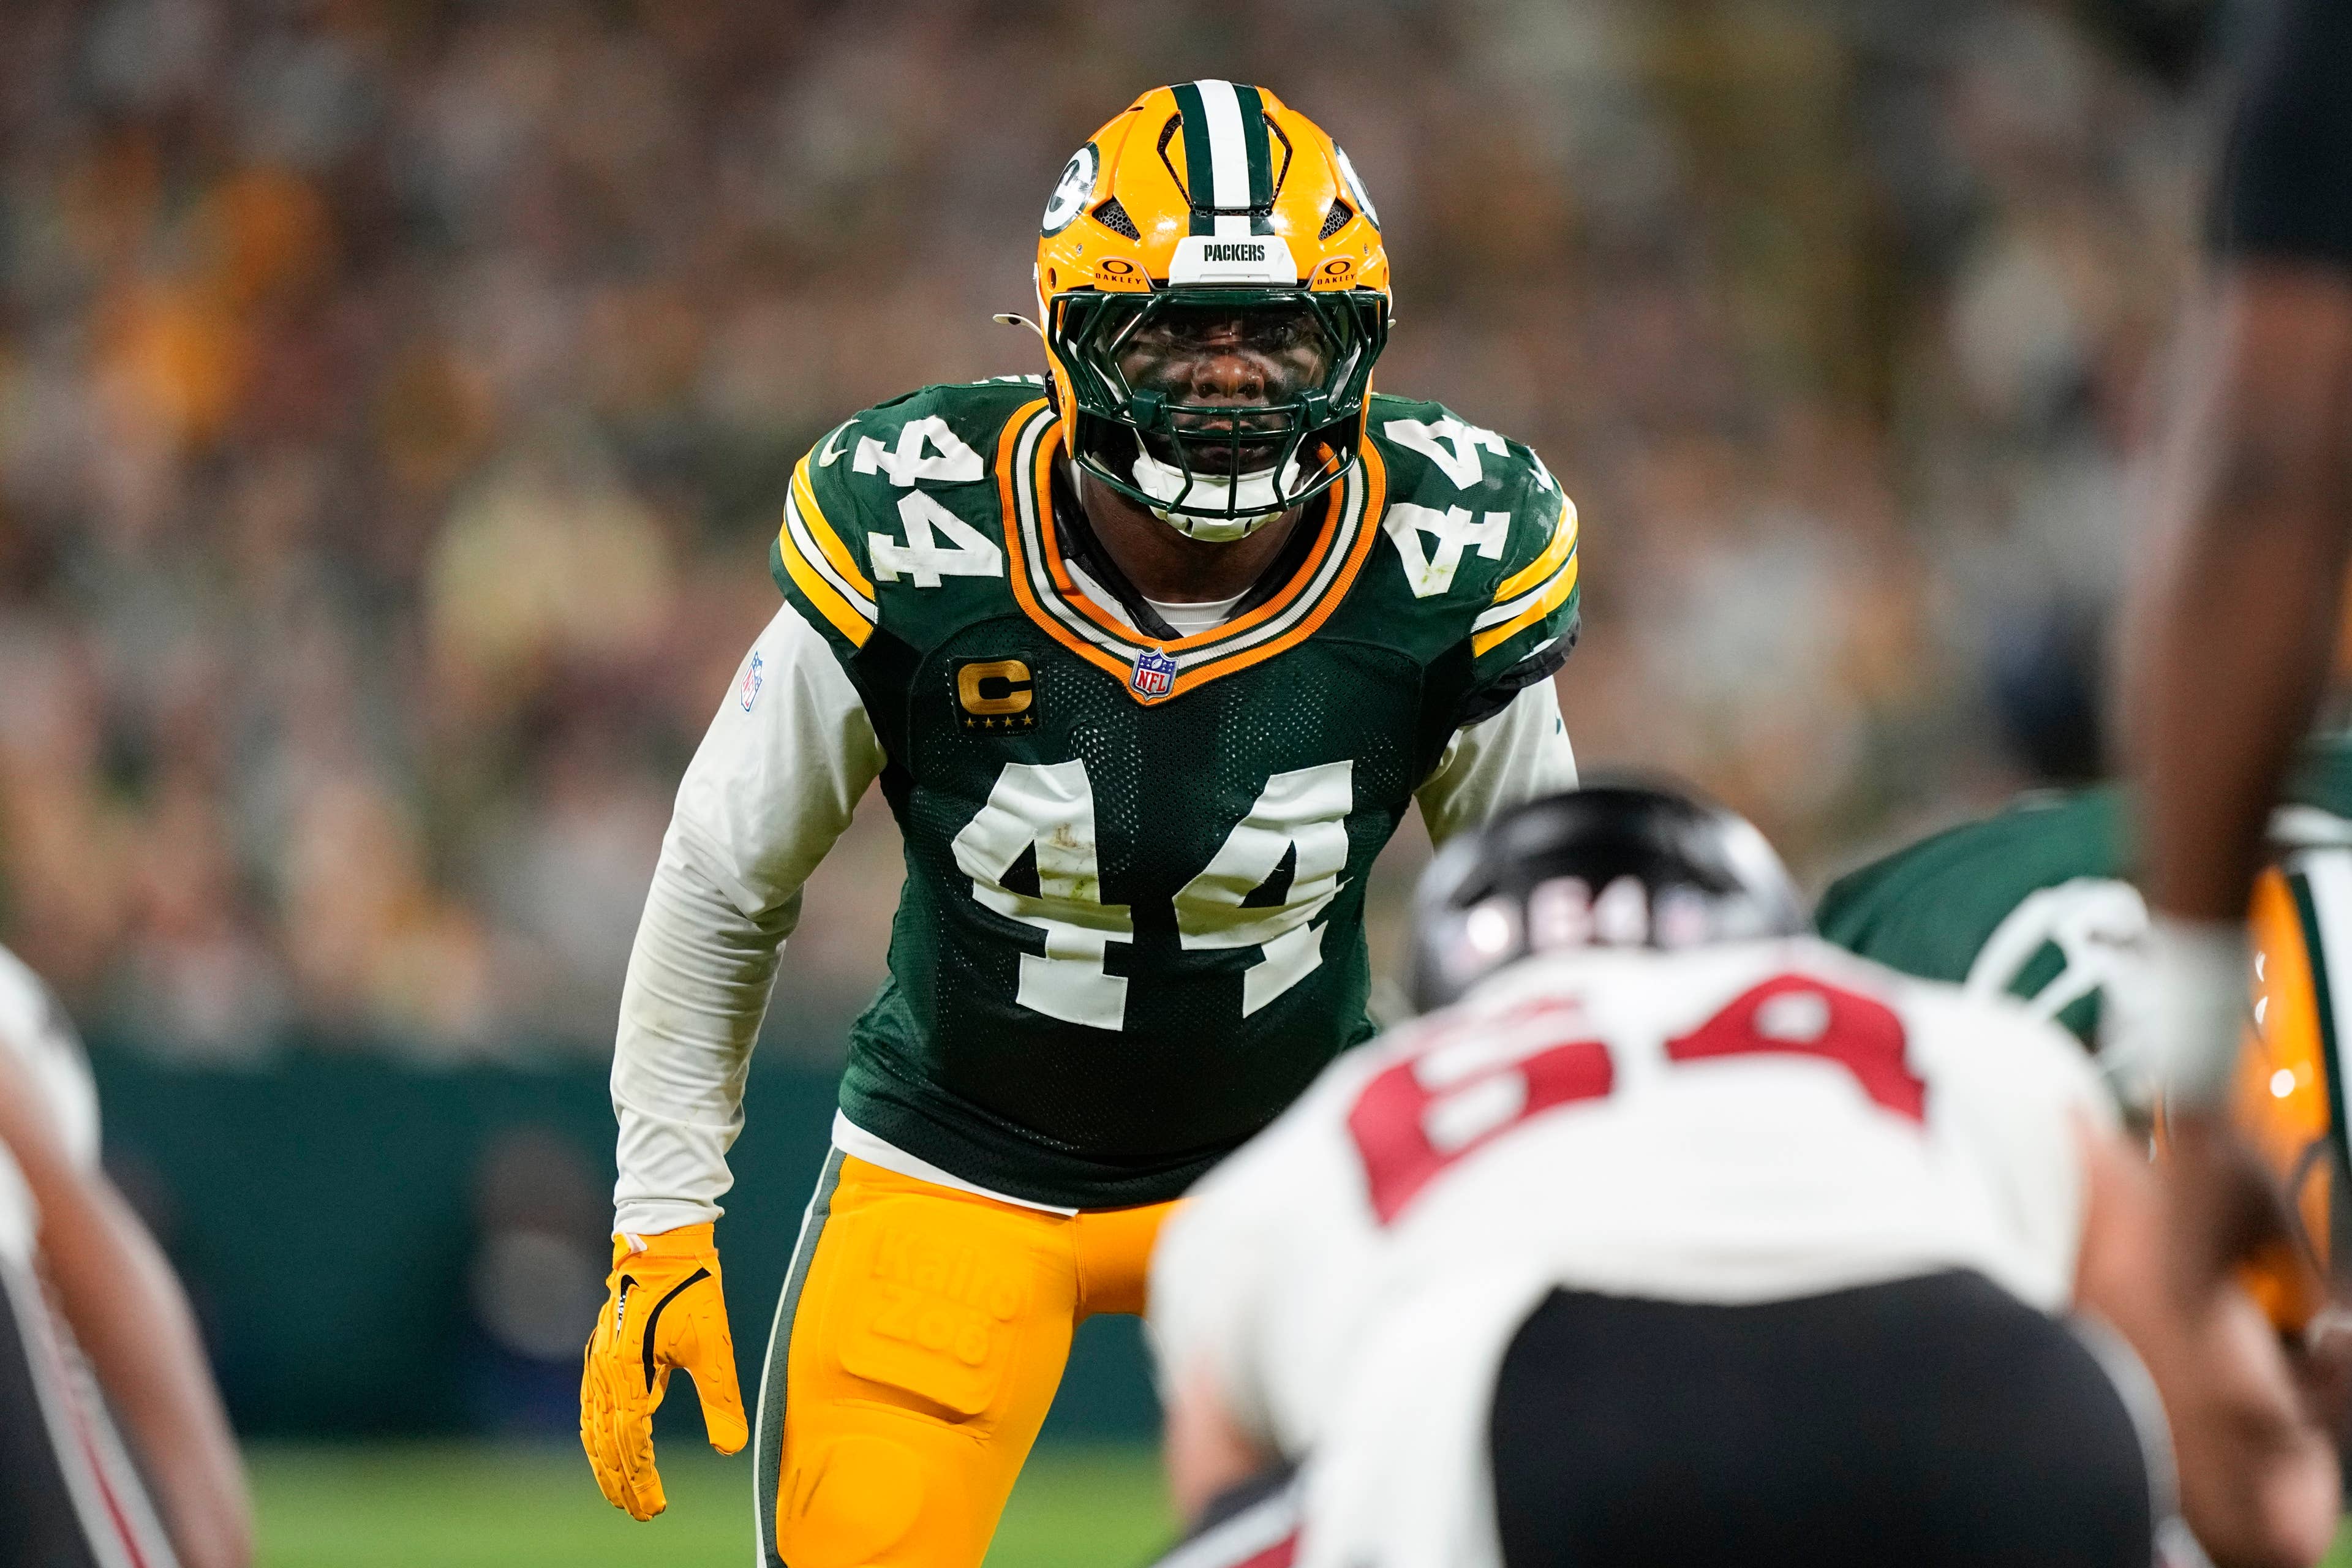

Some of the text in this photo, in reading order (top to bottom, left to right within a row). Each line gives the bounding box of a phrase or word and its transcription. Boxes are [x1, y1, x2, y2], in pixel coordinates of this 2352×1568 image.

[1204, 244, 1265, 262] PACKERS
[1095, 273, 1141, 285] OAKLEY
[1317, 273, 1355, 285] OAKLEY
[851, 415, 1003, 588] 44
[1382, 415, 1510, 598] 44
[957, 659, 1033, 715] C
[1136, 670, 1167, 692] NFL
[951, 758, 1354, 1031] 44
